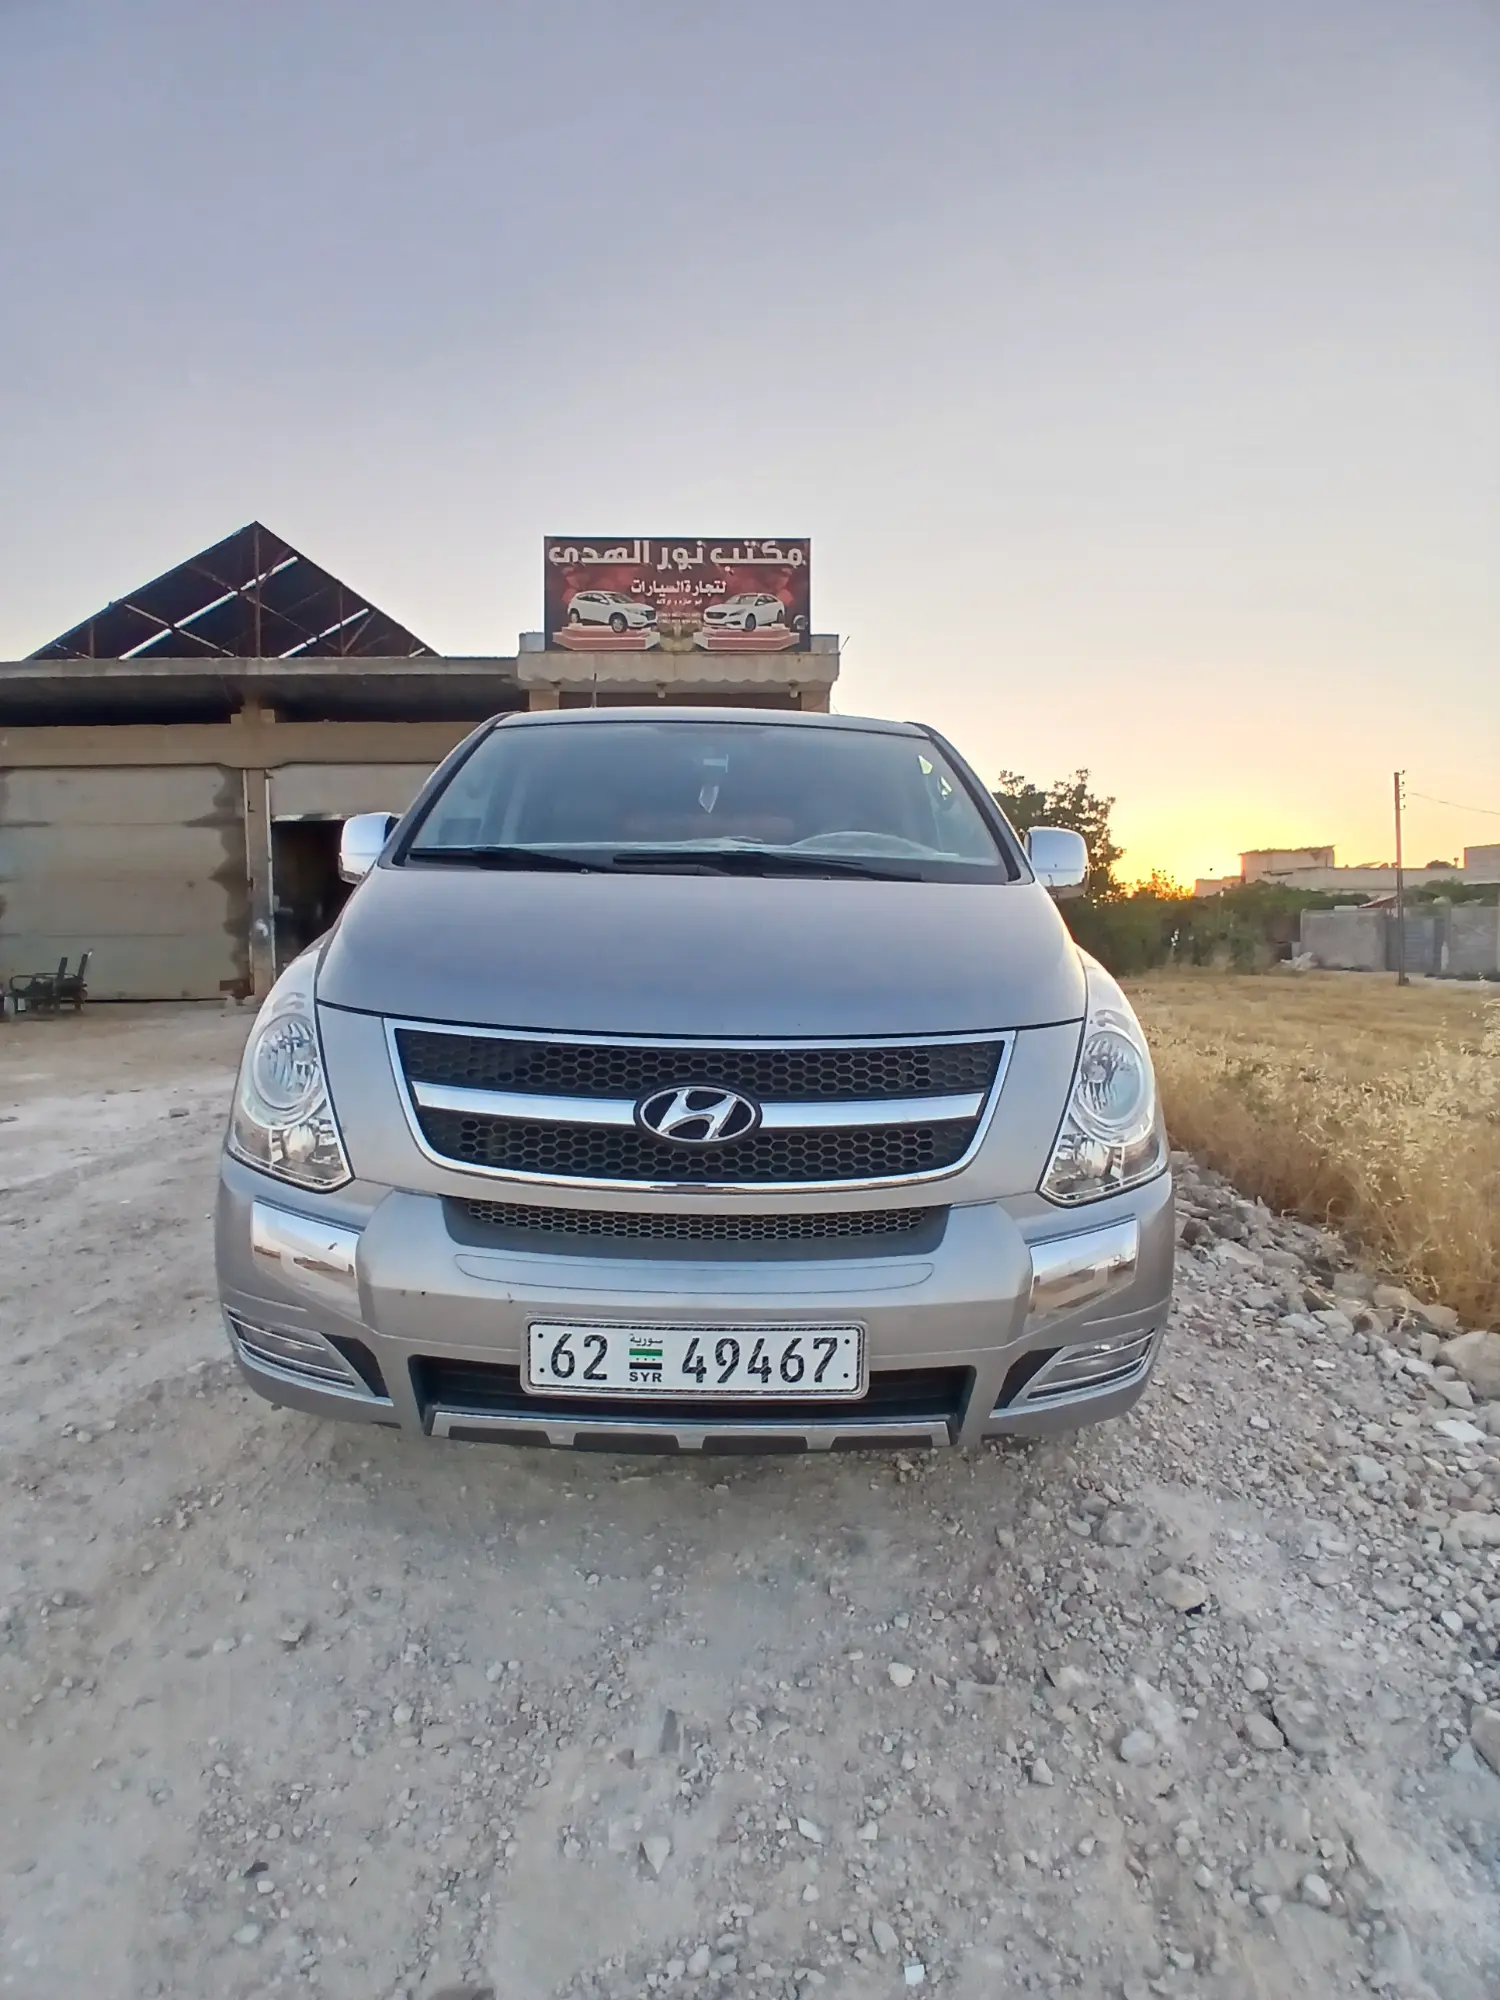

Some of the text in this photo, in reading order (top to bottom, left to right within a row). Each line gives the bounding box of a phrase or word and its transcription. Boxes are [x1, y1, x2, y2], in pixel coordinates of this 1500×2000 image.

[548, 540, 804, 572] مكتب نور الهدى
[630, 579, 684, 597] السيارات
[629, 1333, 663, 1346] سورية
[551, 1333, 838, 1384] 62 49467
[629, 1371, 662, 1383] SYR
